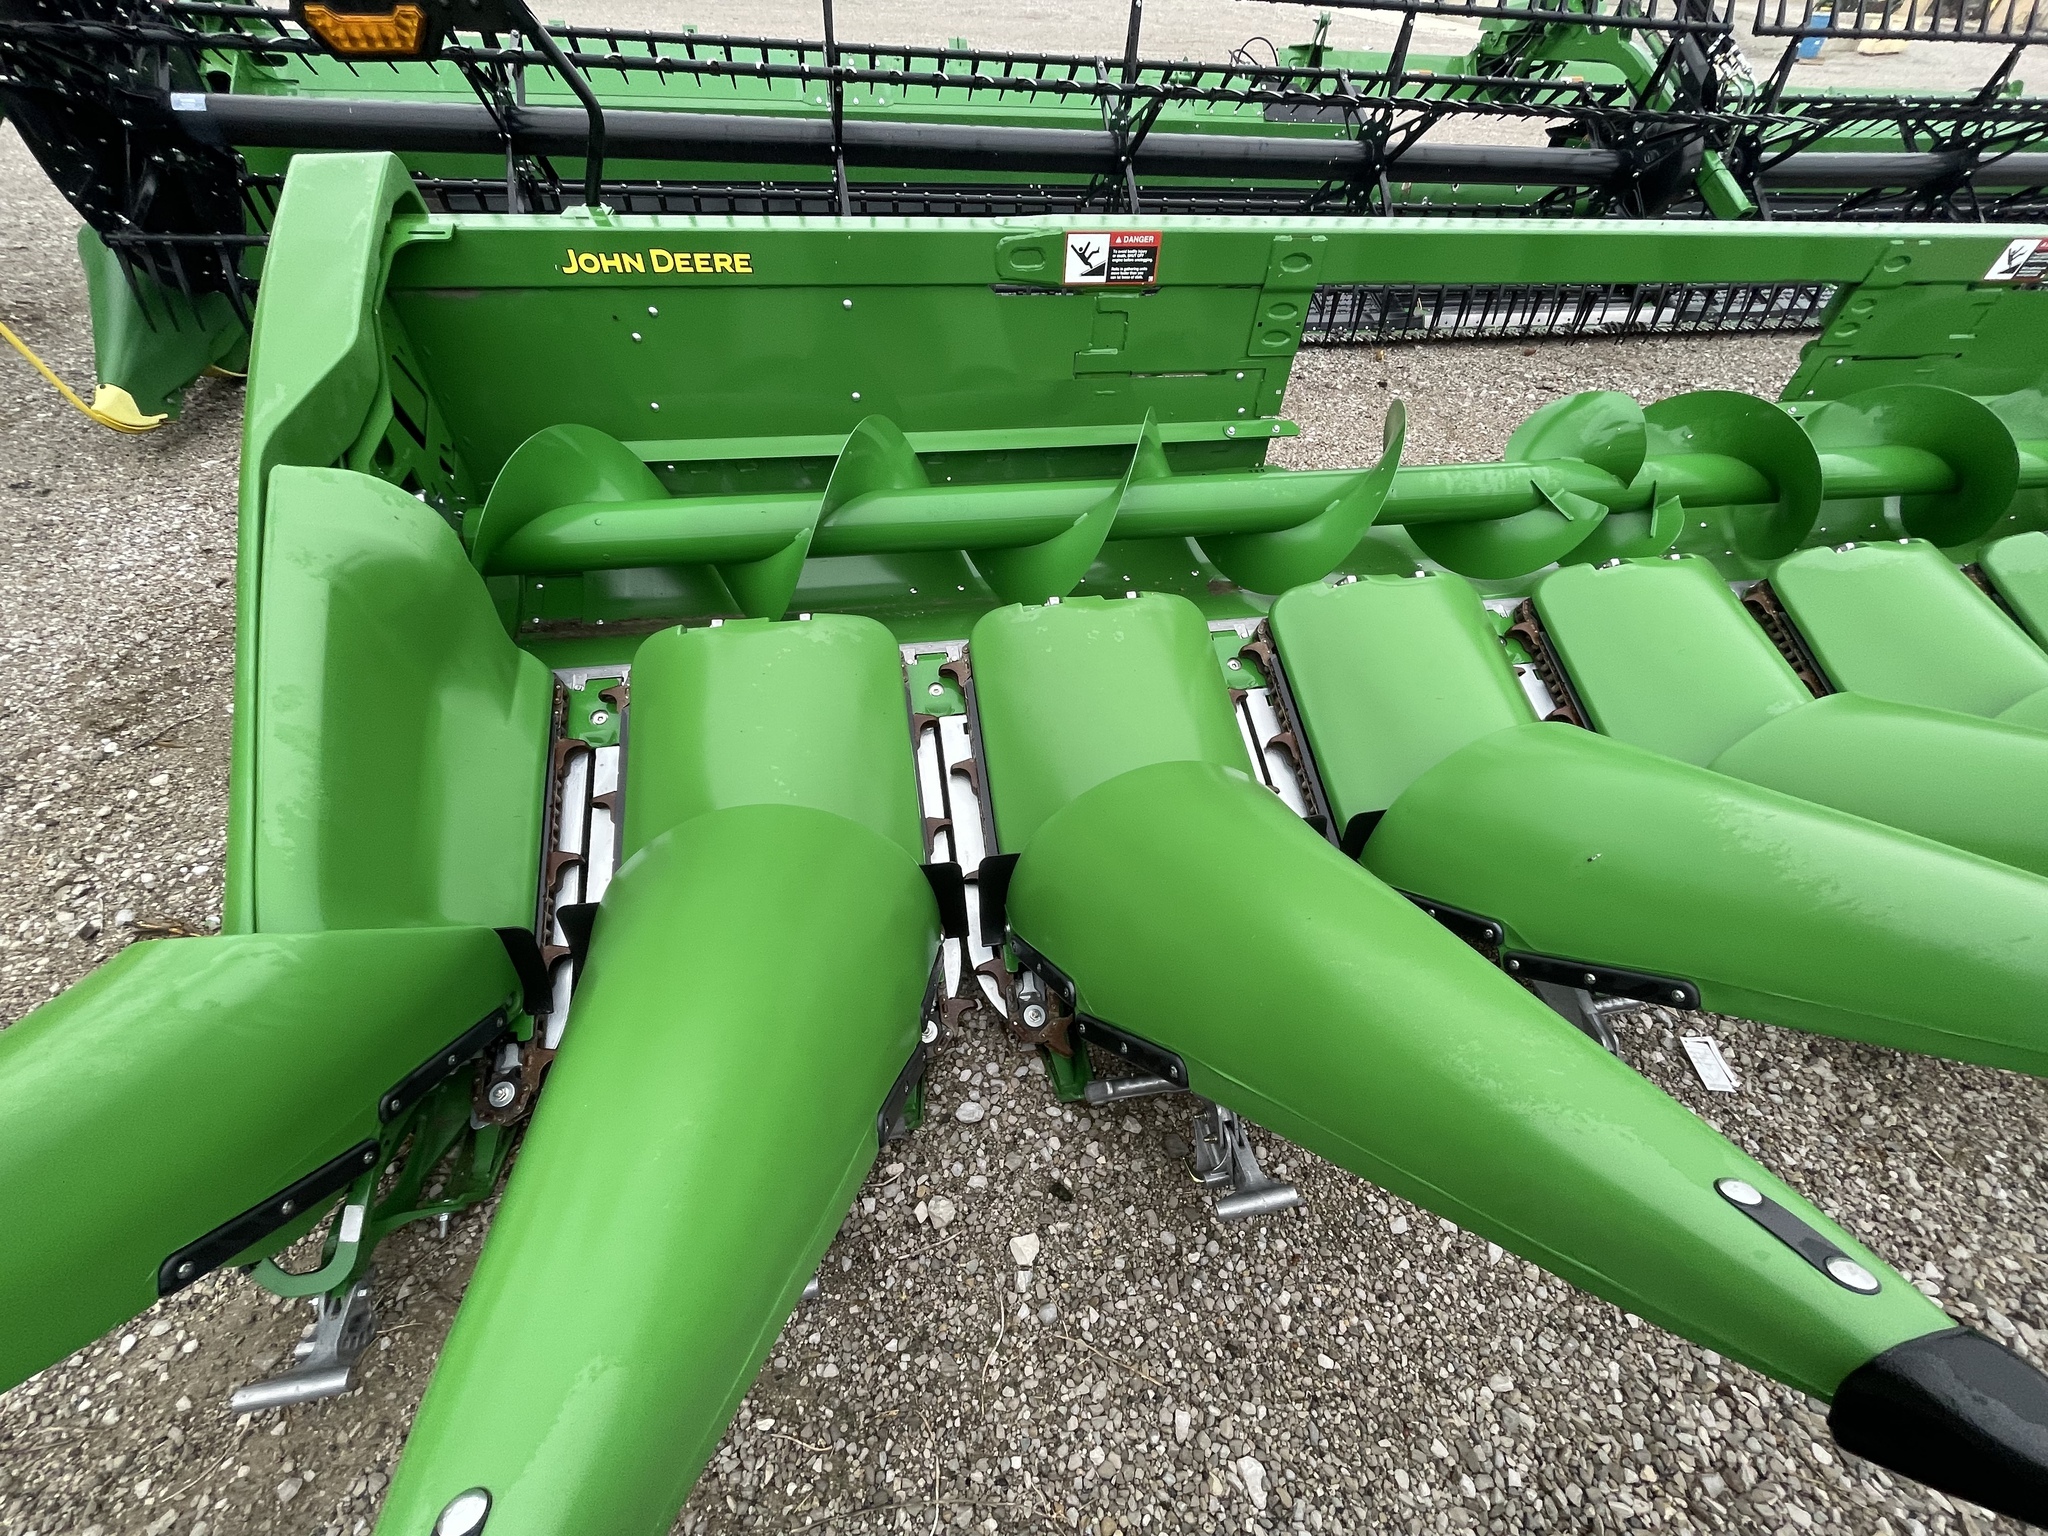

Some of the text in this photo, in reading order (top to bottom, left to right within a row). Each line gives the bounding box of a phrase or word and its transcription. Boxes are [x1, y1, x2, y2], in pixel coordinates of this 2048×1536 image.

[1123, 235, 1154, 243] DANGER
[562, 248, 753, 274] JOHN DEERE
